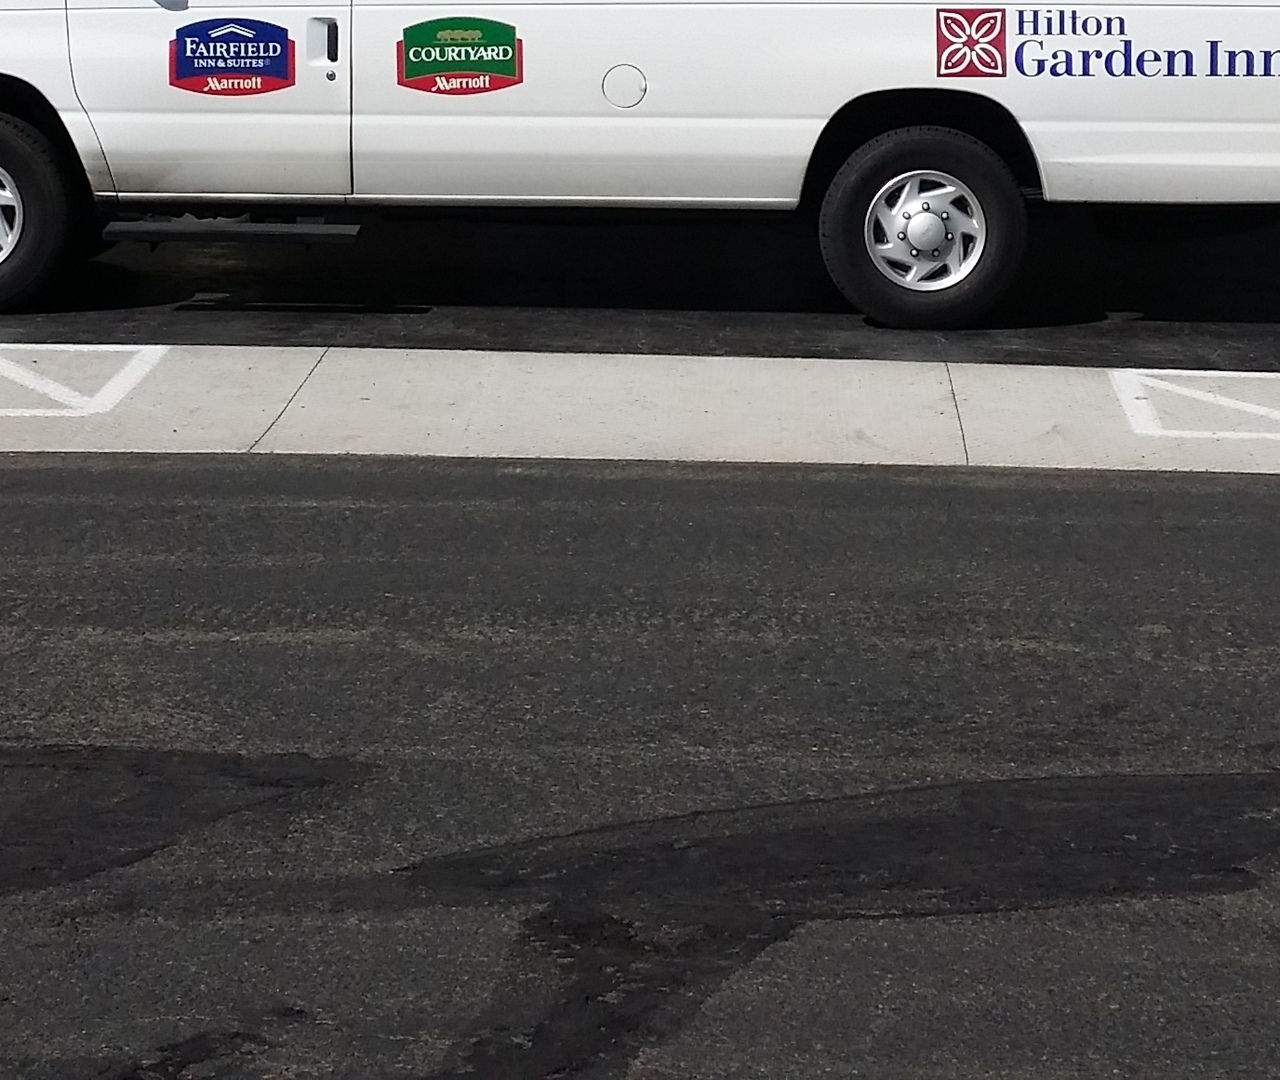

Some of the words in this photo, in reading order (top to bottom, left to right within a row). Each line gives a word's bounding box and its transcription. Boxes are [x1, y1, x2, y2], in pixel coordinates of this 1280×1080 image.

[1015, 9, 1128, 36] Hilton
[184, 37, 281, 58] FAIRFIELD
[409, 45, 513, 63] COURTYARD
[1014, 39, 1195, 78] Garden
[203, 76, 262, 92] Marriott
[431, 75, 490, 91] Marriott
